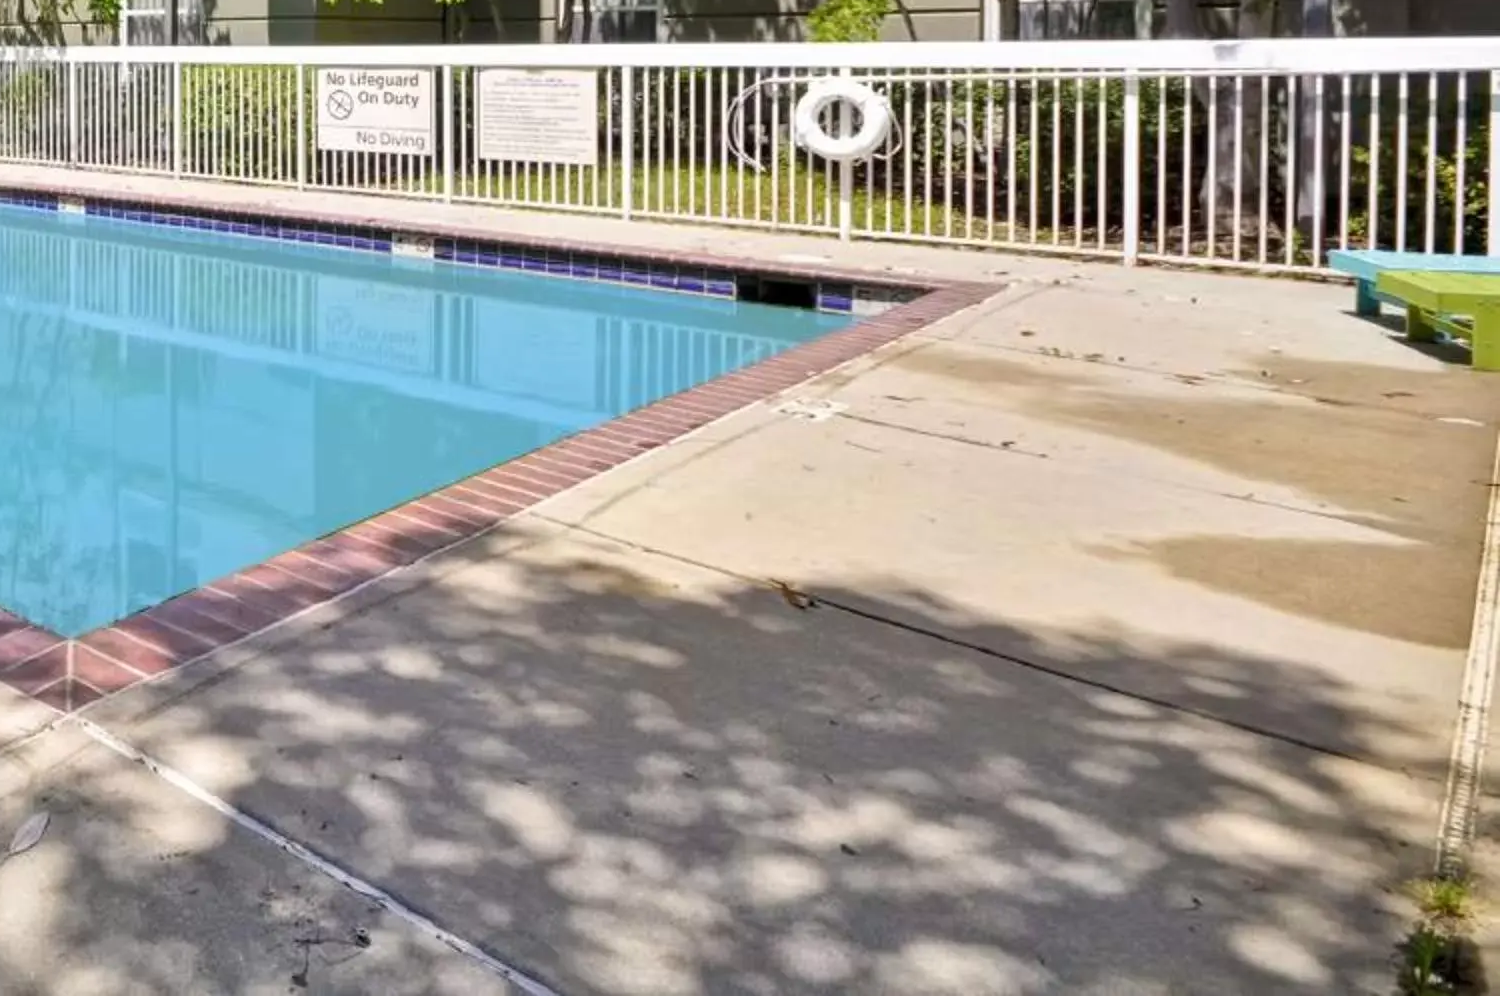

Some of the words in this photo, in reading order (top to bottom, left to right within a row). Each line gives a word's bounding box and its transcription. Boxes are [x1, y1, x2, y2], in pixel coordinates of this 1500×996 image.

[326, 72, 346, 86] No
[350, 71, 419, 90] Lifeguard
[357, 91, 379, 104] On
[383, 91, 420, 109] Duty
[356, 131, 377, 145] No
[380, 132, 425, 150] Diving
